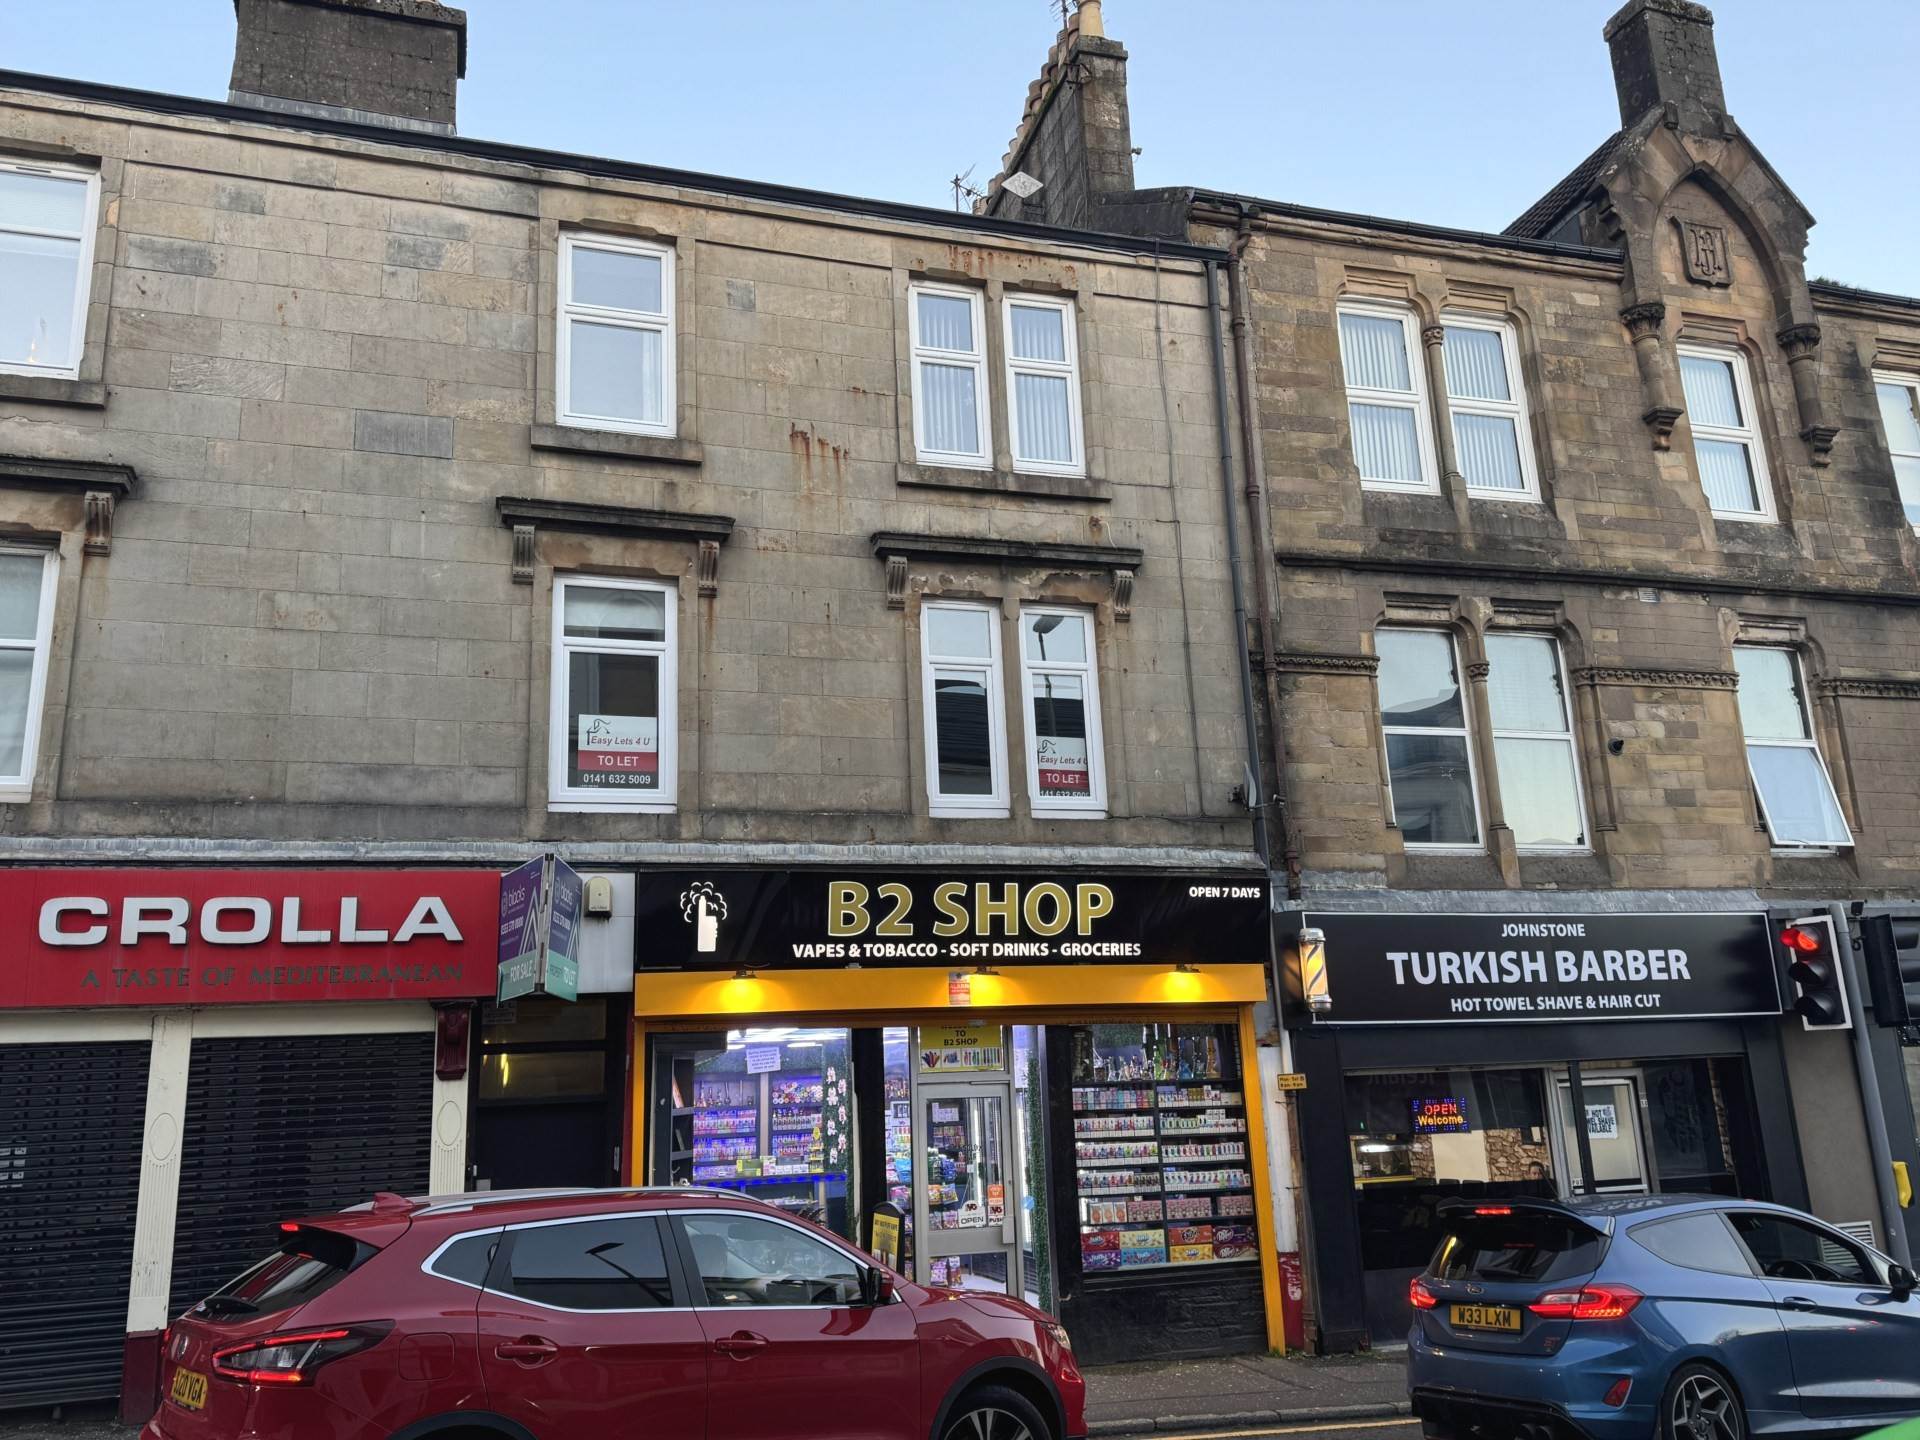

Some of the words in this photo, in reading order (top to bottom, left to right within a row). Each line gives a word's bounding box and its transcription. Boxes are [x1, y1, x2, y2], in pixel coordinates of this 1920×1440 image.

[591, 736, 612, 746] Easy
[615, 737, 633, 745] Lets
[635, 737, 641, 745] 4
[643, 737, 651, 745] U
[597, 755, 614, 766] TO
[617, 755, 639, 766] LET
[1040, 756, 1058, 765] Easy
[583, 773, 605, 783] 0141
[609, 774, 626, 784] 632
[629, 775, 651, 784] 5009
[1046, 773, 1060, 783] TO
[1062, 774, 1080, 784] LET
[1189, 886, 1220, 898] OPEN
[1222, 887, 1230, 898] 7
[1231, 887, 1261, 899] DAYS
[828, 881, 914, 937] B2
[933, 881, 1114, 937] SHOP
[38, 896, 464, 946] CROLLA
[1502, 923, 1586, 937] JOHNSTONE
[792, 943, 845, 958] VAPES
[848, 943, 861, 958] &
[863, 943, 938, 958] TOBACCO
[950, 942, 990, 957] SOFT
[992, 942, 1049, 957] DRINKS
[1060, 941, 1142, 957] GROCERIES
[510, 965, 520, 983] FOR
[520, 959, 533, 981] SALE
[1386, 950, 1548, 985] TURKISH
[1555, 949, 1692, 983] BARBER
[81, 968, 100, 988] A
[112, 967, 190, 988] TASTE
[203, 966, 236, 987] OF
[250, 963, 464, 986] MEDITERRANEAN
[1451, 998, 1482, 1012] HOT
[1483, 996, 1535, 1011] TOWEL
[1536, 995, 1584, 1010] SHAVE
[1585, 995, 1597, 1009] &
[1599, 994, 1632, 1009] HAIR
[1634, 993, 1661, 1008] CUT
[956, 1038, 978, 1046] SHOP
[1424, 1104, 1457, 1115] OPEN
[1591, 1109, 1602, 1118] HOT
[1418, 1114, 1464, 1126] Welcome
[1598, 1117, 1615, 1126] SHAVE
[1588, 1124, 1613, 1133] VAILABLE
[961, 1216, 984, 1225] OPEN
[1485, 1309, 1512, 1328] LXM
